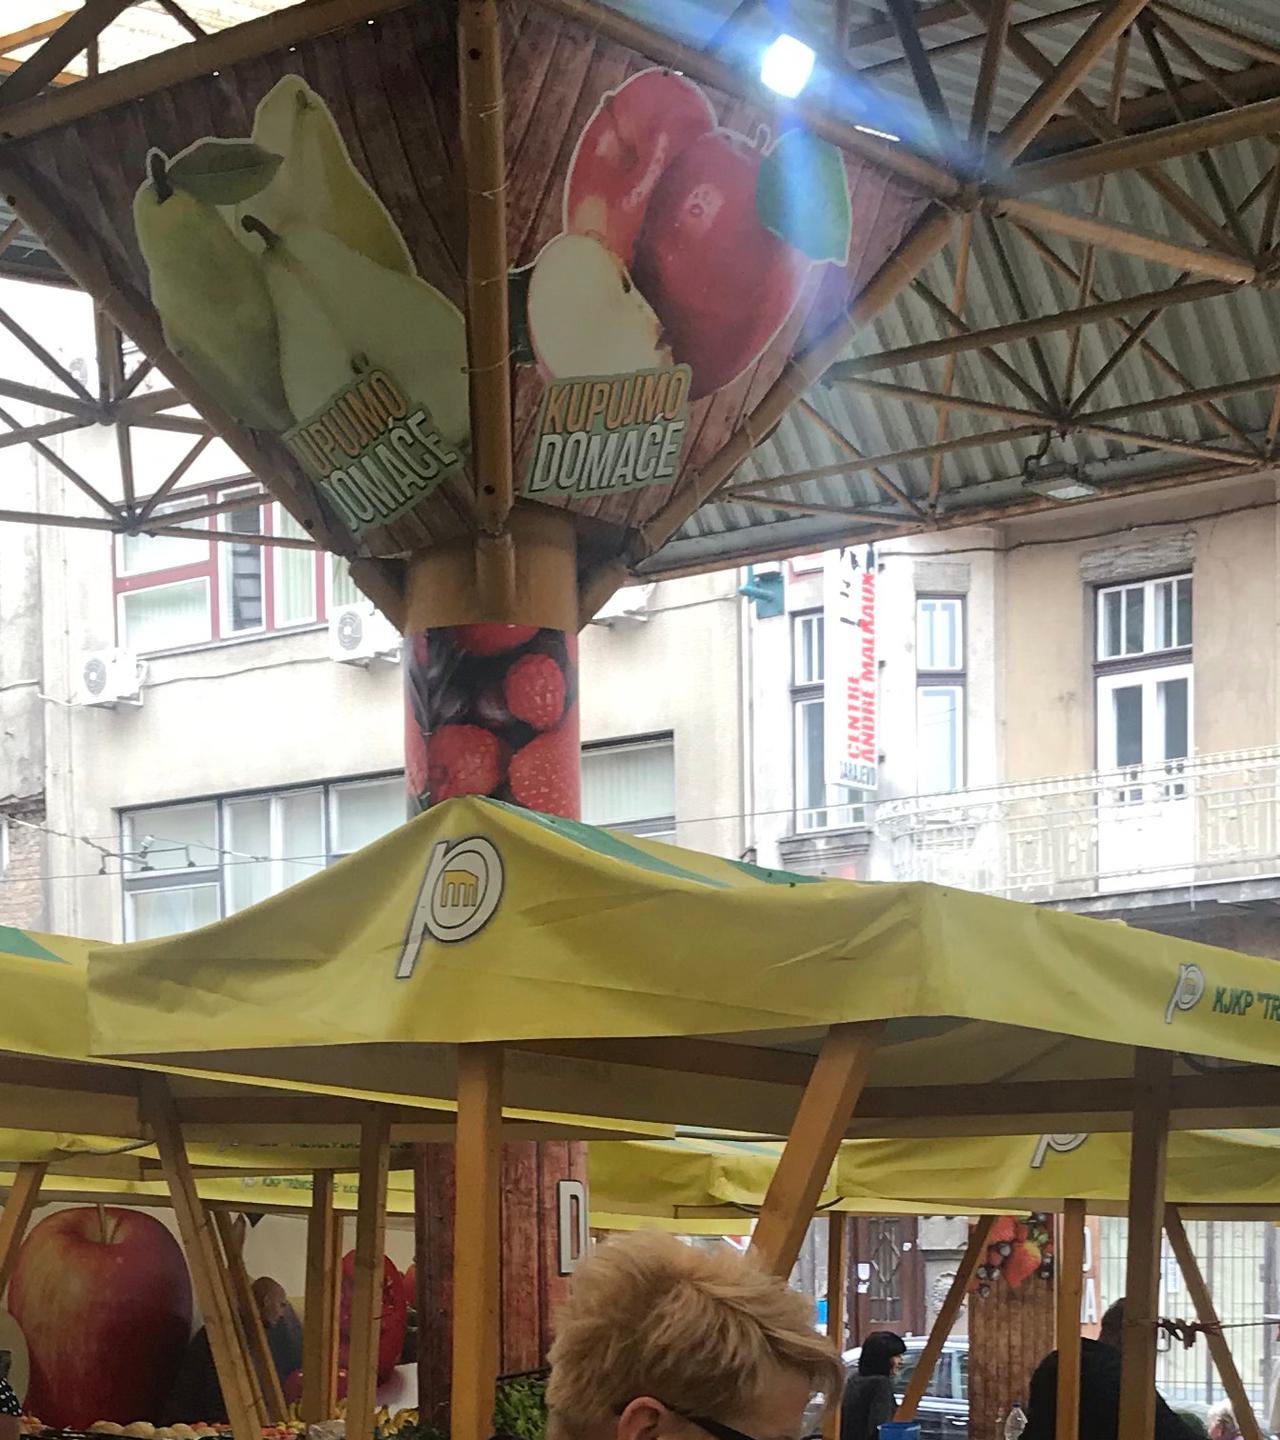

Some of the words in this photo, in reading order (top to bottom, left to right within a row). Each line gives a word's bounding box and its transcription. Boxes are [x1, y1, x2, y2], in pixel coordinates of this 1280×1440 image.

[280, 369, 407, 478] UPUJMO
[542, 370, 690, 436] KUPUJMO
[533, 412, 687, 492] DOMAĆE
[1212, 985, 1254, 1016] KJKP
